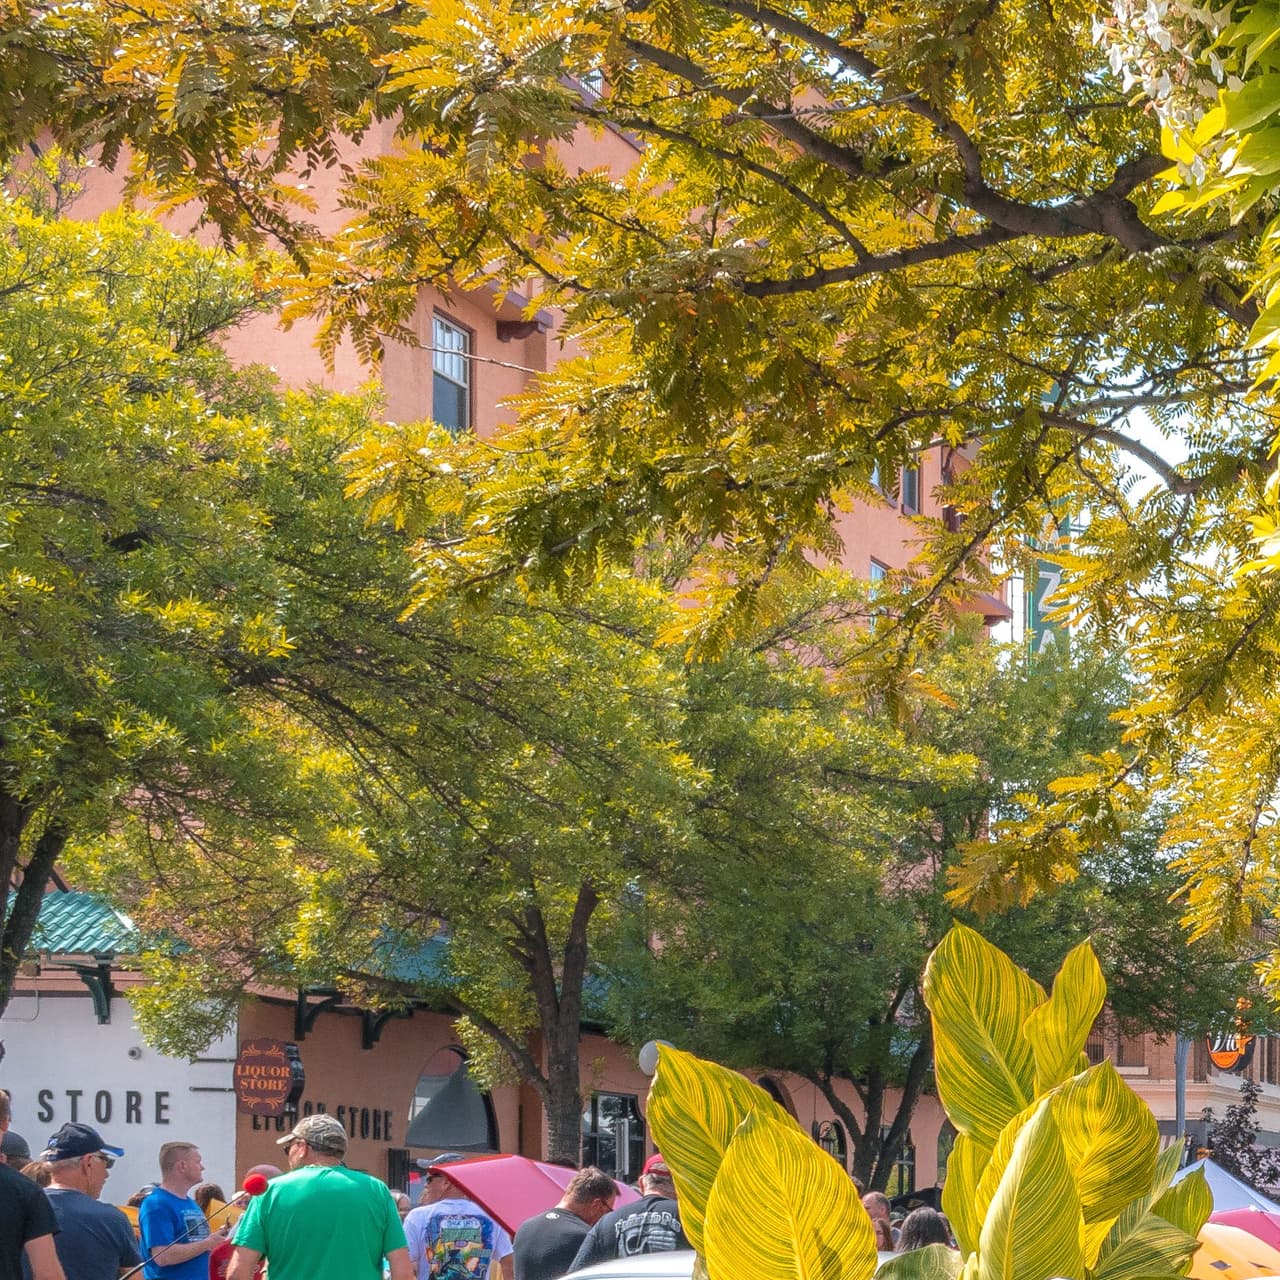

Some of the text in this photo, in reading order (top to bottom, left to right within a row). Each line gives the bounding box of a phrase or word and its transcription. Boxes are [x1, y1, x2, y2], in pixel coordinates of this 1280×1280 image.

[237, 1065, 290, 1079] LIQUOR
[240, 1080, 287, 1091] STORE
[38, 1089, 170, 1124] STORE
